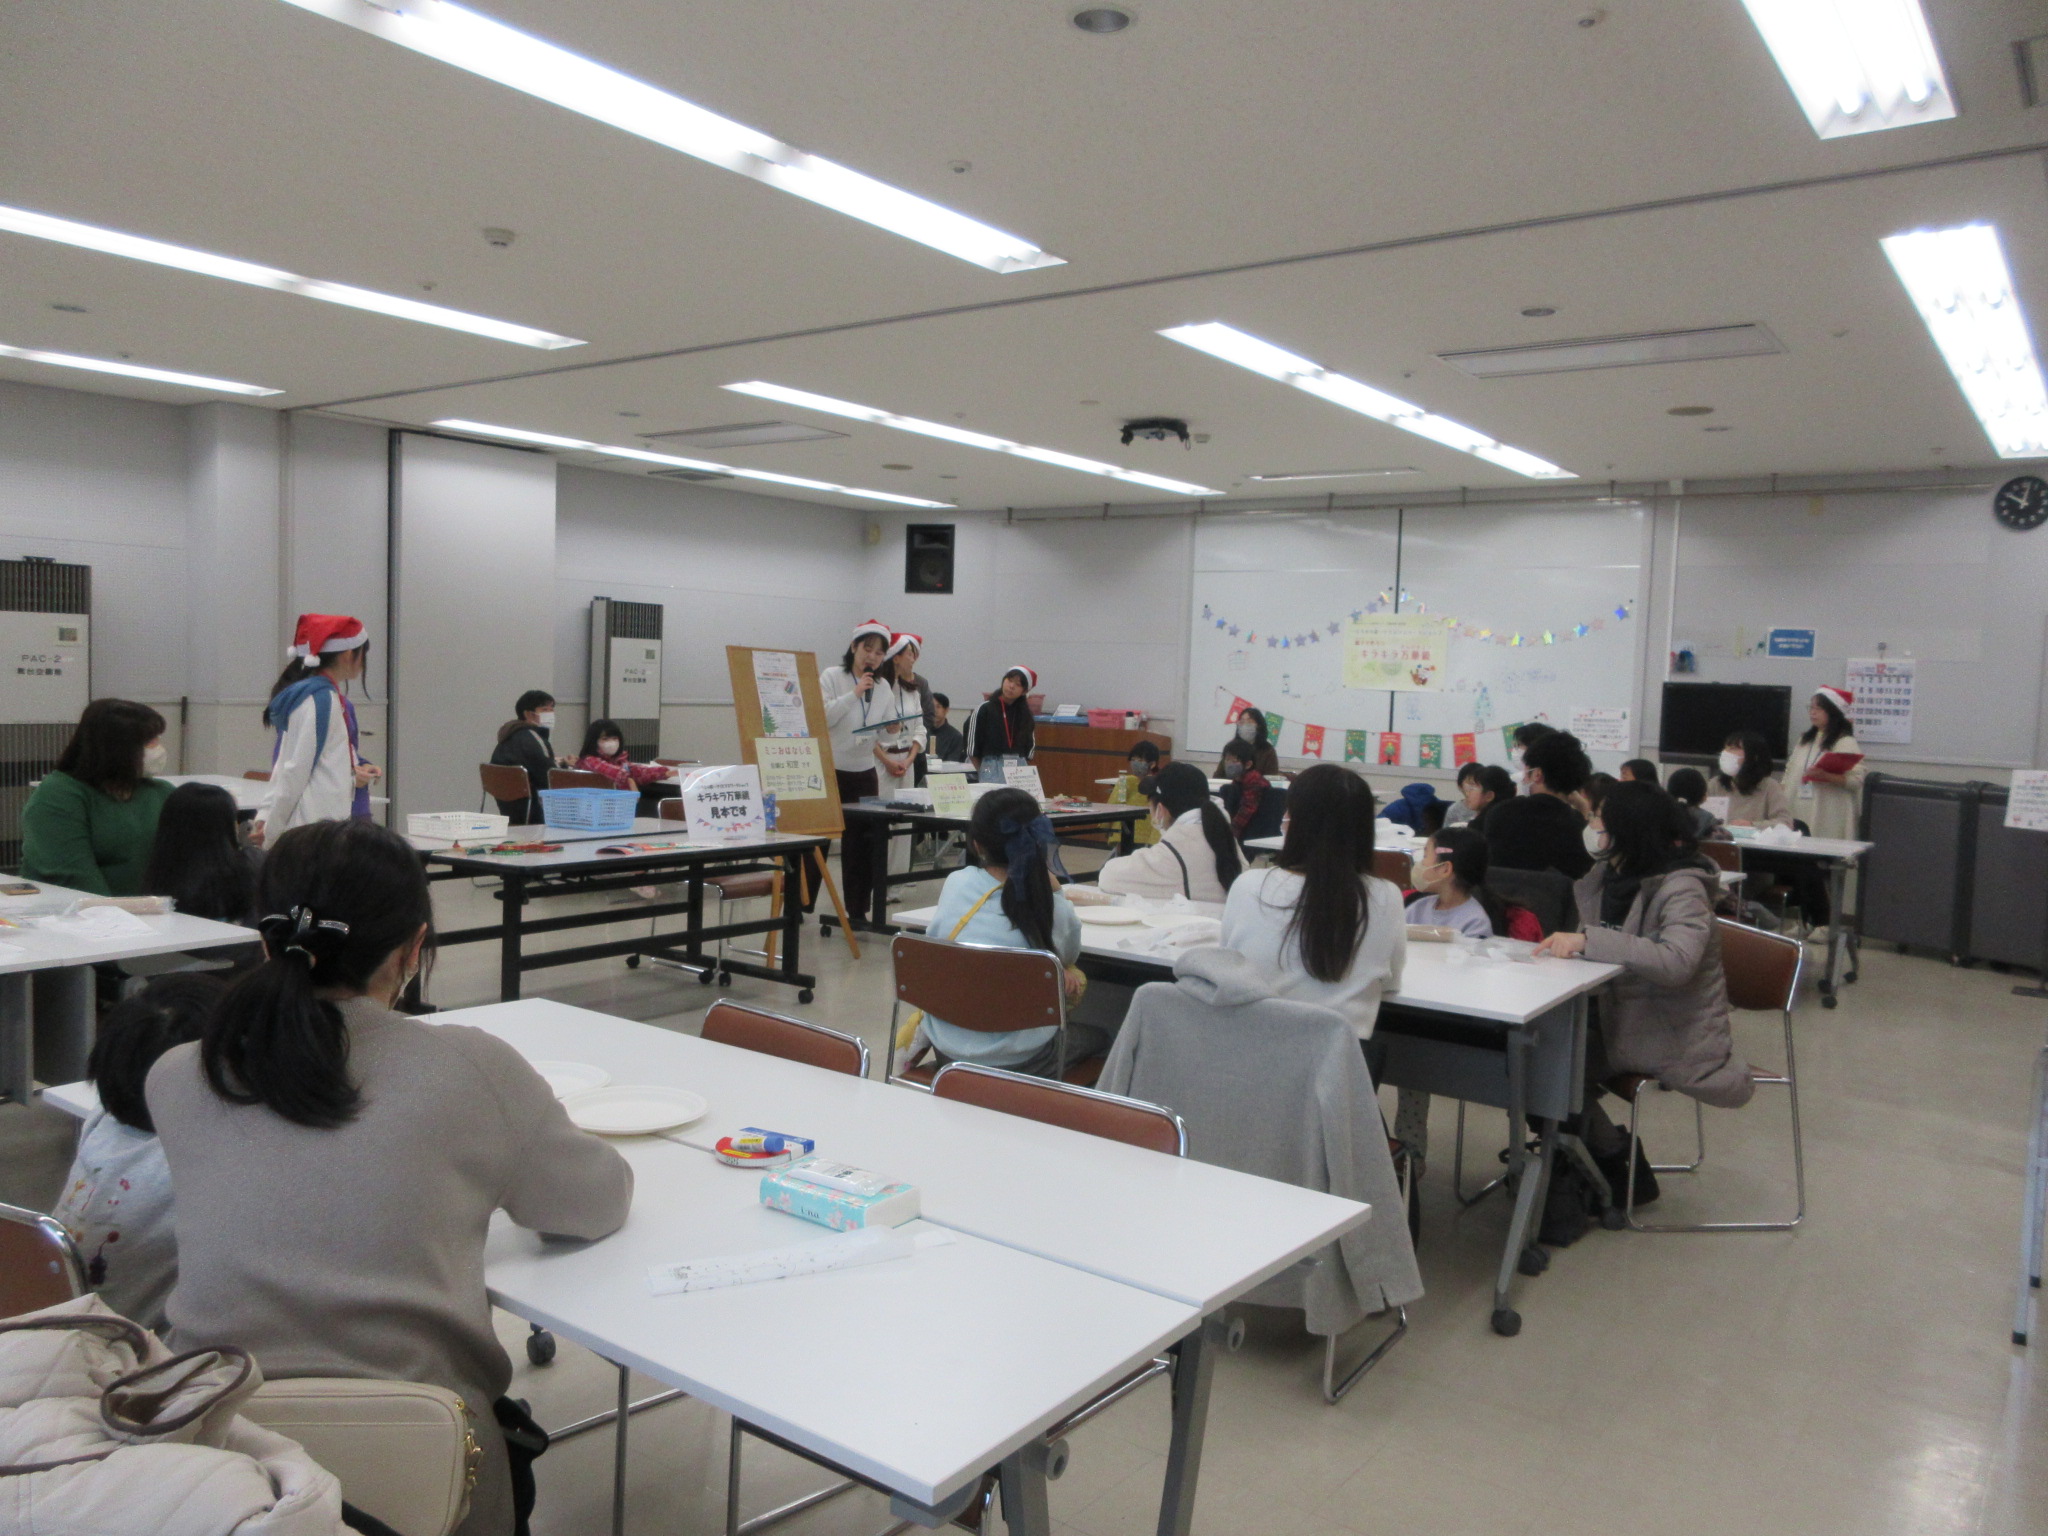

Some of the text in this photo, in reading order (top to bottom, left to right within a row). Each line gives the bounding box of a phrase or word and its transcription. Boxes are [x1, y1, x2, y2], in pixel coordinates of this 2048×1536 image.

[21, 654, 62, 663] PAC-2
[710, 804, 748, 819] 見本です
